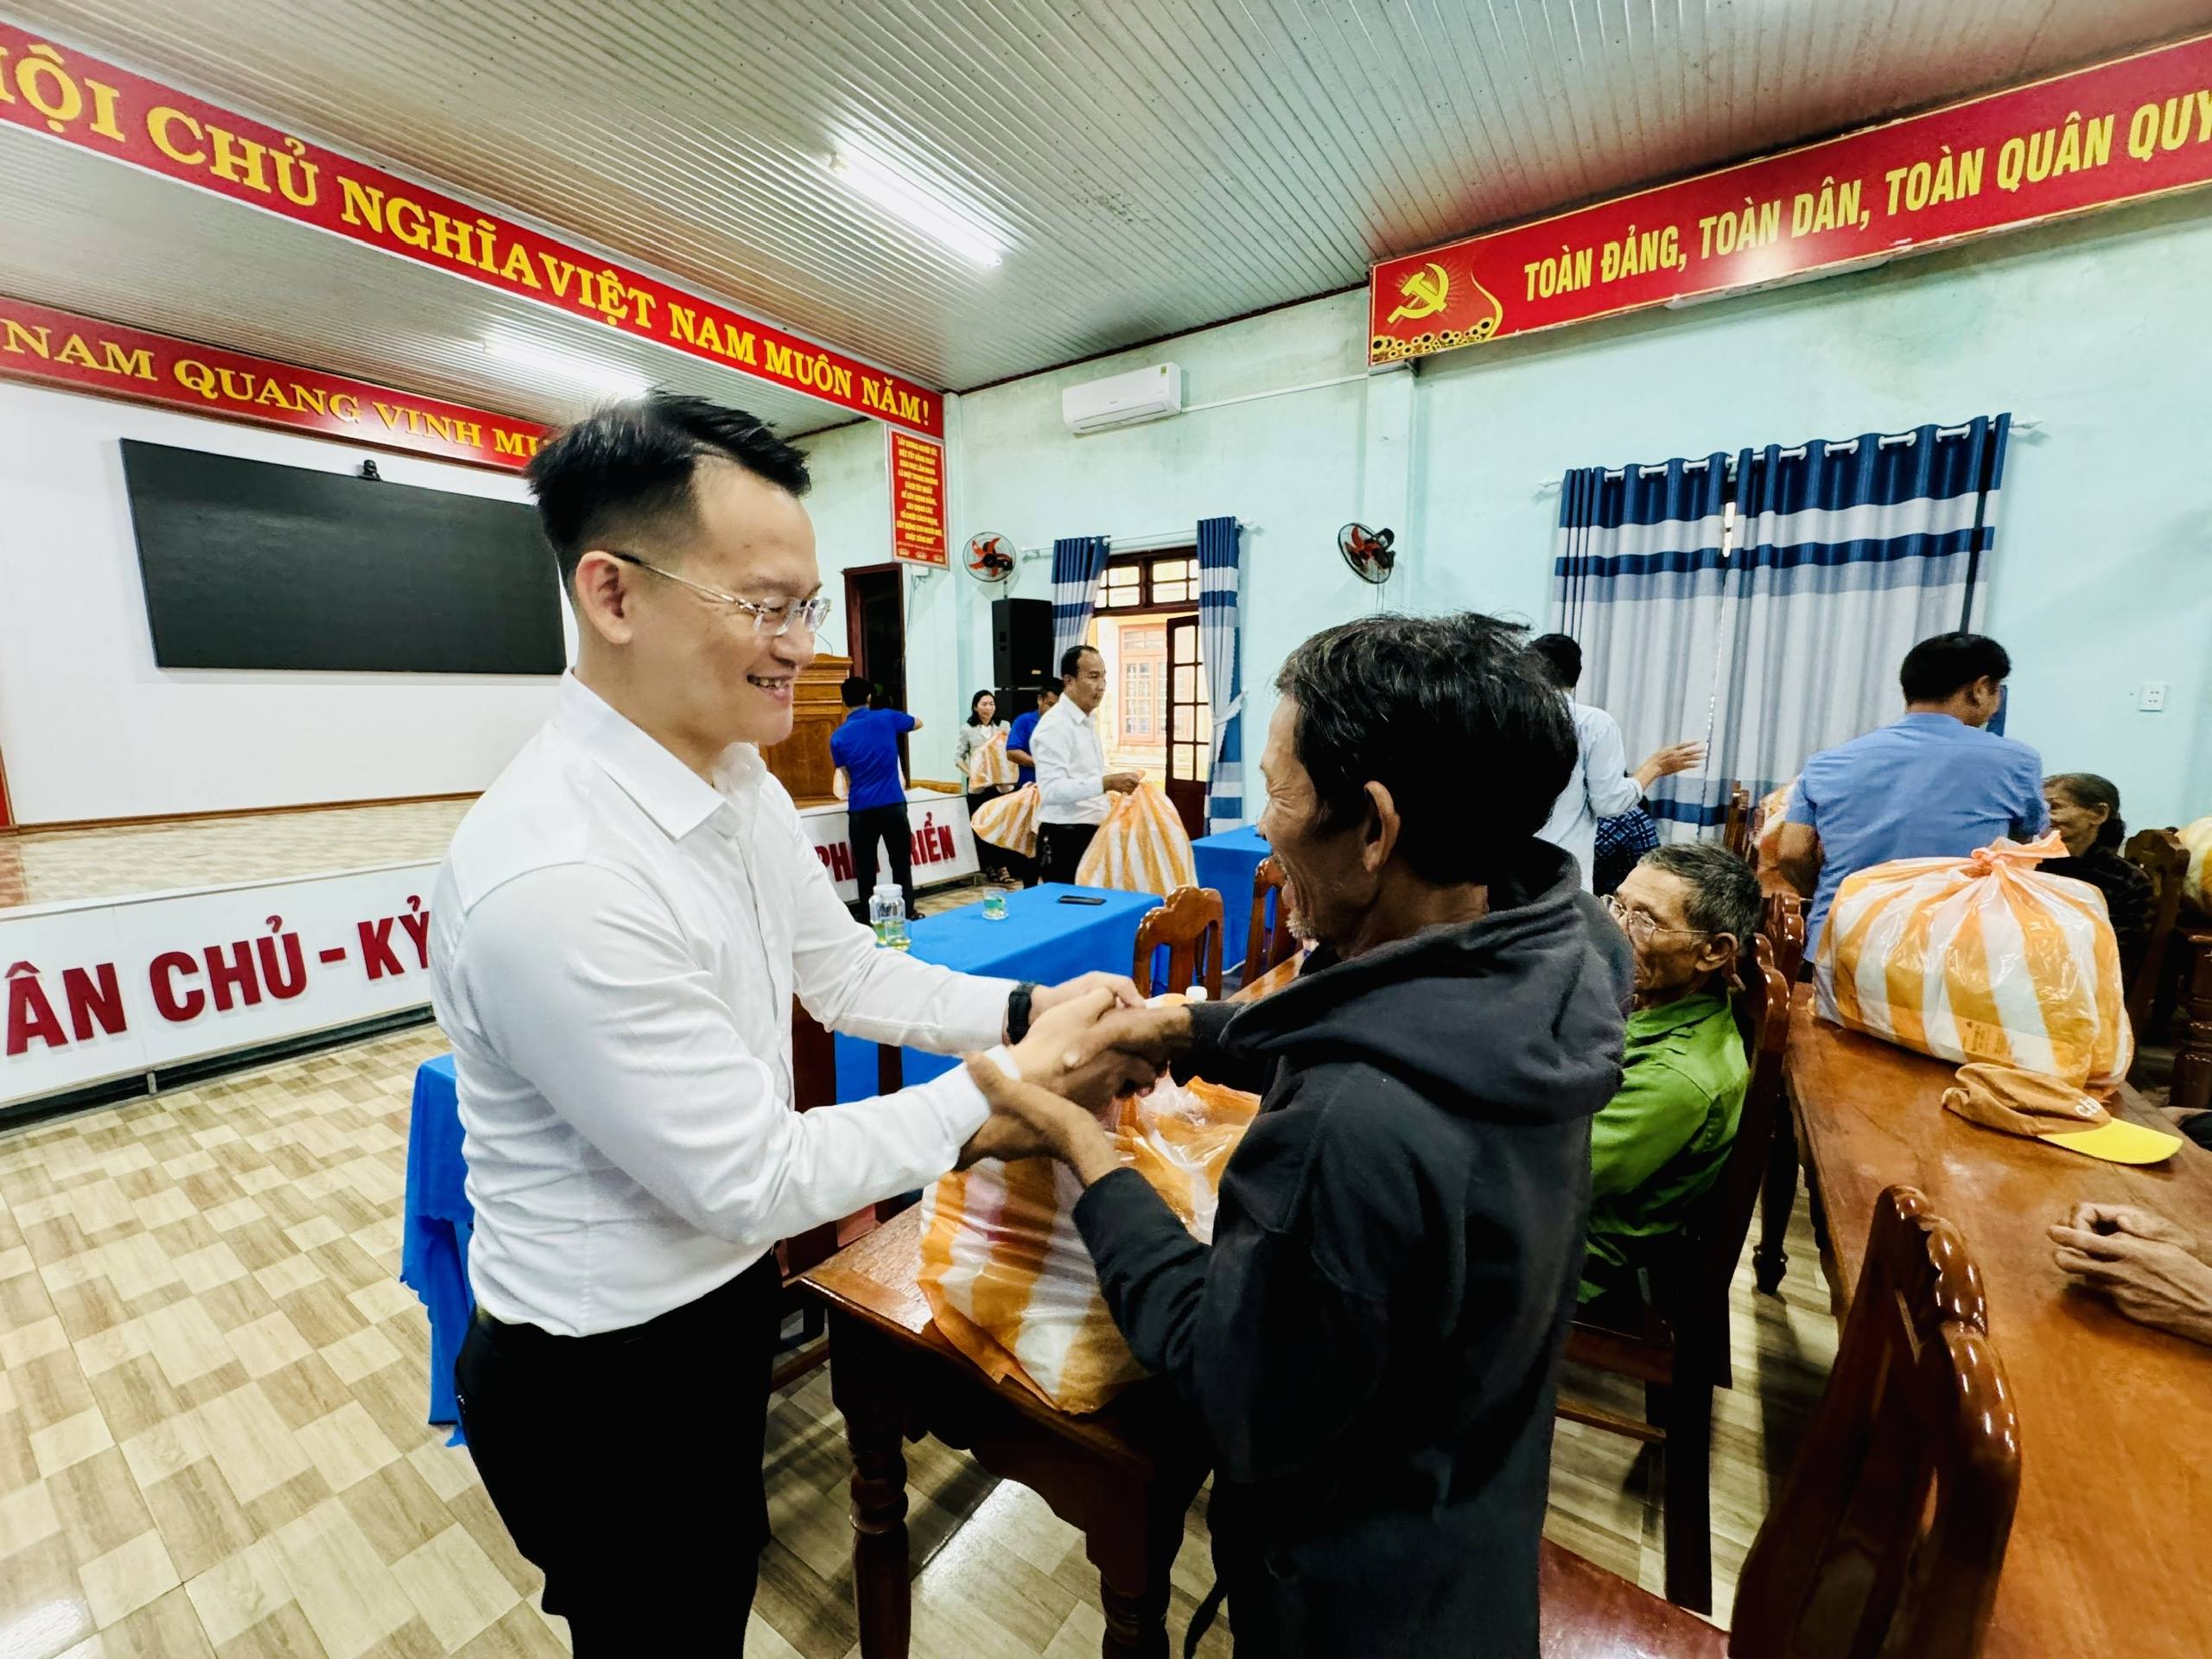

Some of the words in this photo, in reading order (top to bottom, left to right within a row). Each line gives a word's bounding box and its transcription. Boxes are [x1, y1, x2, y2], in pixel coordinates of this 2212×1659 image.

[0, 43, 124, 142] ỘI
[147, 106, 319, 207] CHỦ
[538, 251, 656, 327] VIỆT
[668, 302, 757, 365] NAM
[764, 339, 852, 398] MUÔN
[861, 376, 930, 426] NĂM!
[1524, 245, 1592, 302] TOÀN
[1600, 224, 1688, 283] ĐẢNG,
[1699, 196, 1782, 259] TOÀN
[1790, 175, 1871, 238] DÂN,
[1885, 145, 1986, 216] TOÀN
[1996, 111, 2116, 193] QUÂN
[0, 318, 158, 381] NAM
[174, 359, 363, 423] QUANG
[372, 401, 482, 449] VINH
[910, 811, 957, 866] RIỂN
[4, 960, 127, 1058] ÂN
[149, 914, 308, 1022] CHỦ
